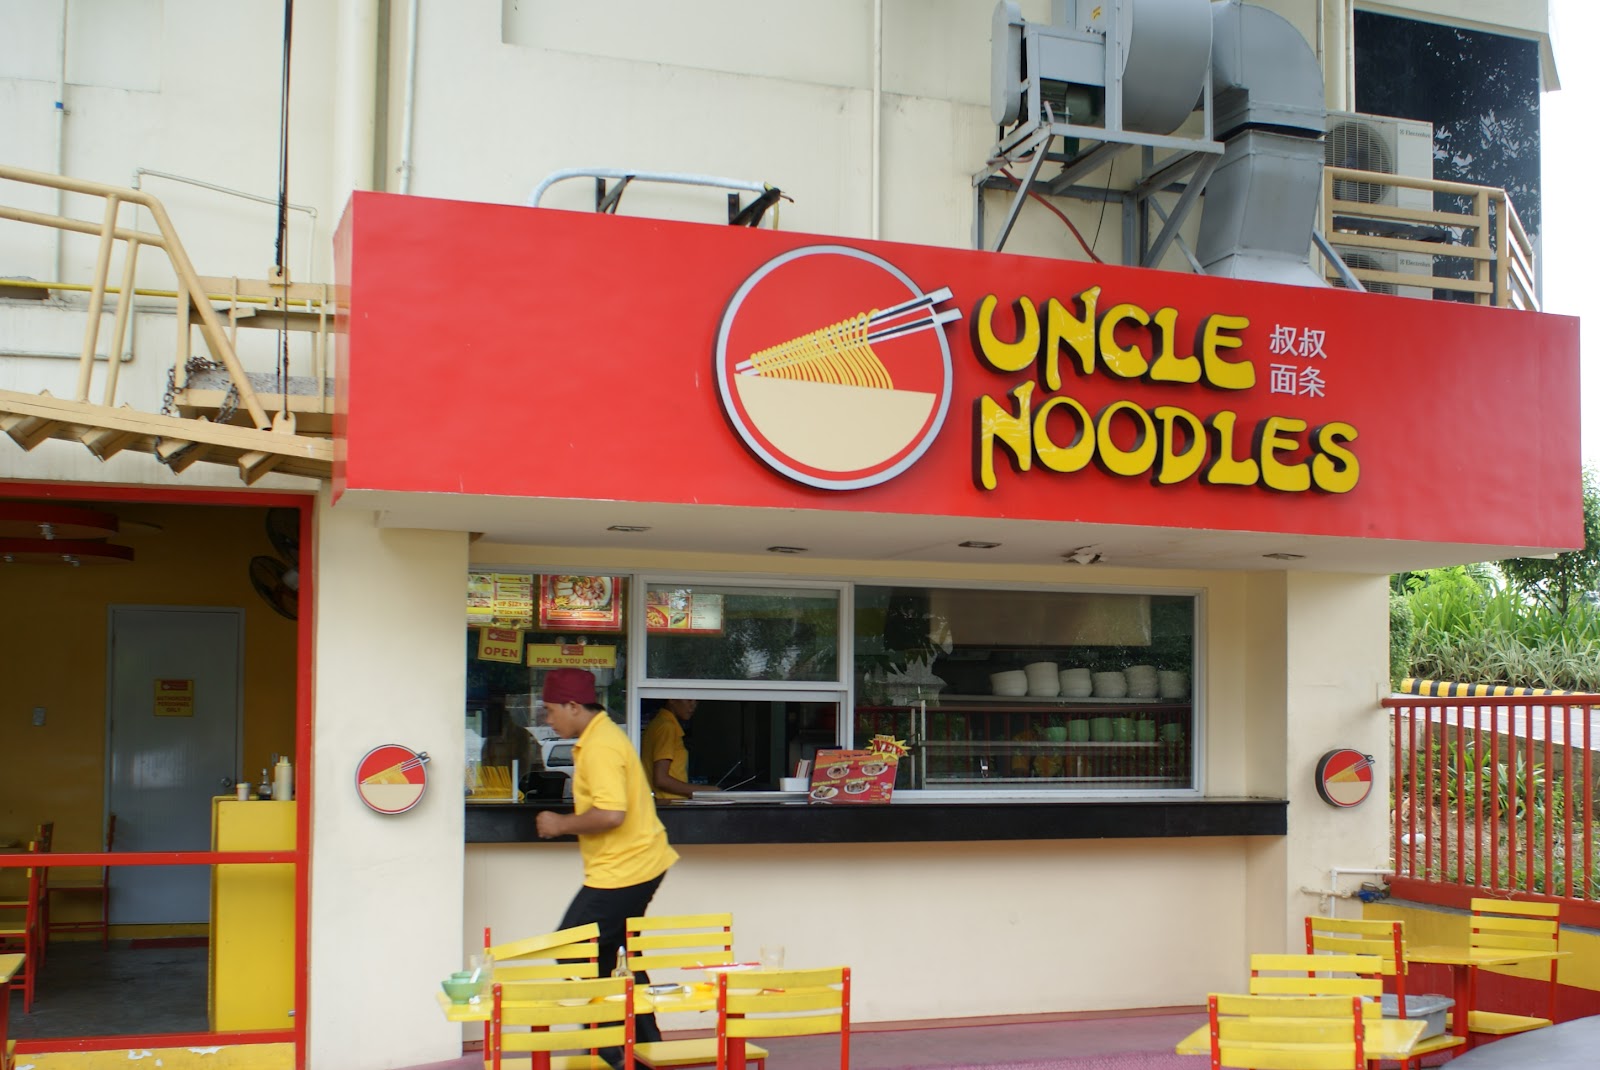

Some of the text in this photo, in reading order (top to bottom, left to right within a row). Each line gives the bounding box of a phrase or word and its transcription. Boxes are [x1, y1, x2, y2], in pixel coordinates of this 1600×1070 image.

[971, 285, 1256, 392] UNCLE
[1269, 323, 1328, 360] 叔叔
[1269, 363, 1327, 398] 面条
[972, 381, 1361, 494] NOODLES
[483, 646, 518, 658] OPEN
[871, 739, 905, 757] NEW
